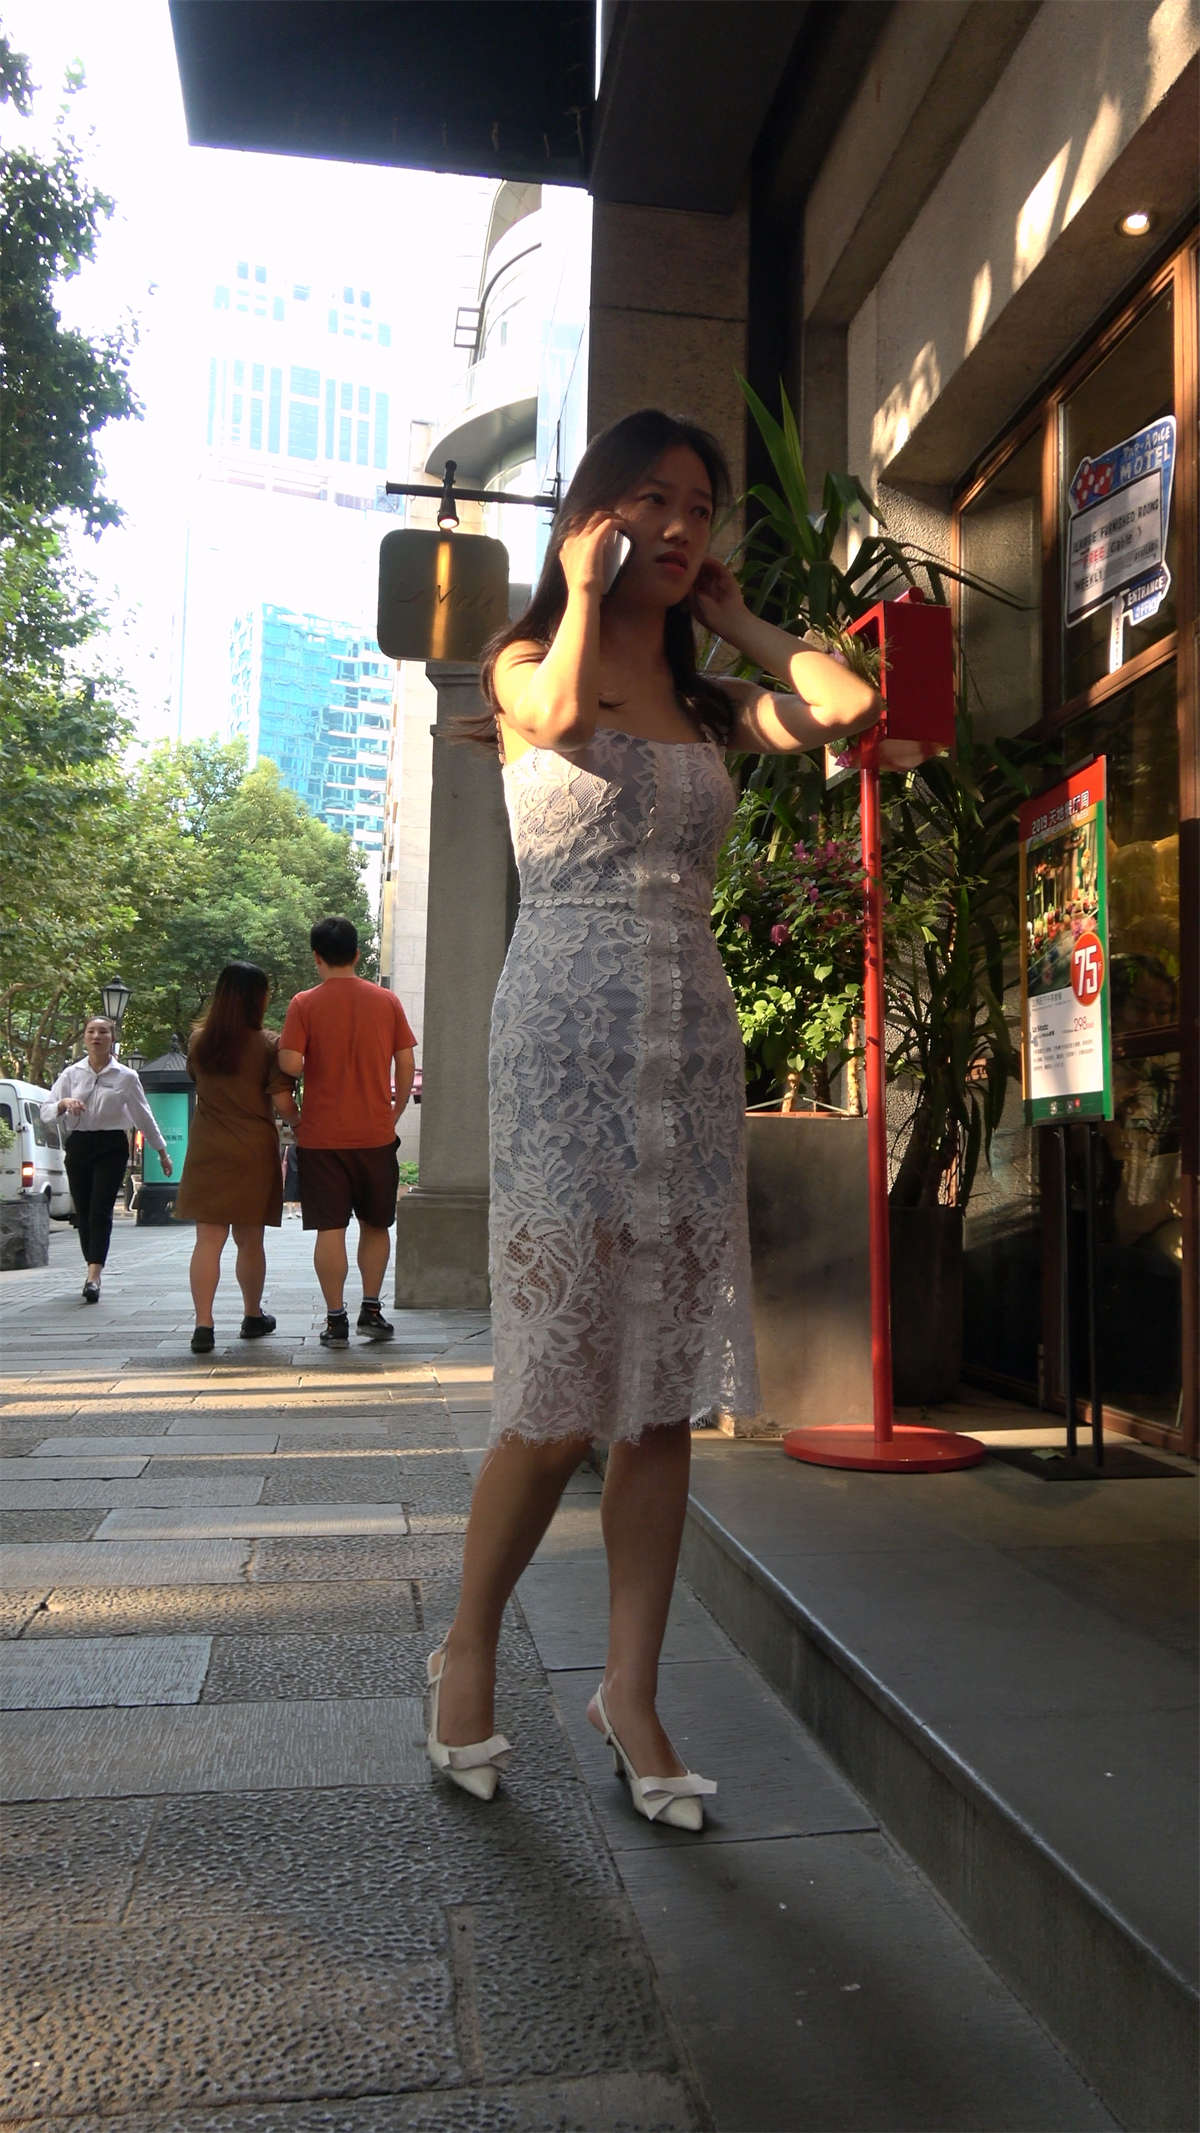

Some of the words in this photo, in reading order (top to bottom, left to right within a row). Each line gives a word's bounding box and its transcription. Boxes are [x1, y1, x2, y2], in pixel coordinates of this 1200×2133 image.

[1120, 442, 1171, 480] MOTEL
[1127, 575, 1165, 606] ENTRANCE
[1074, 945, 1098, 997] 75
